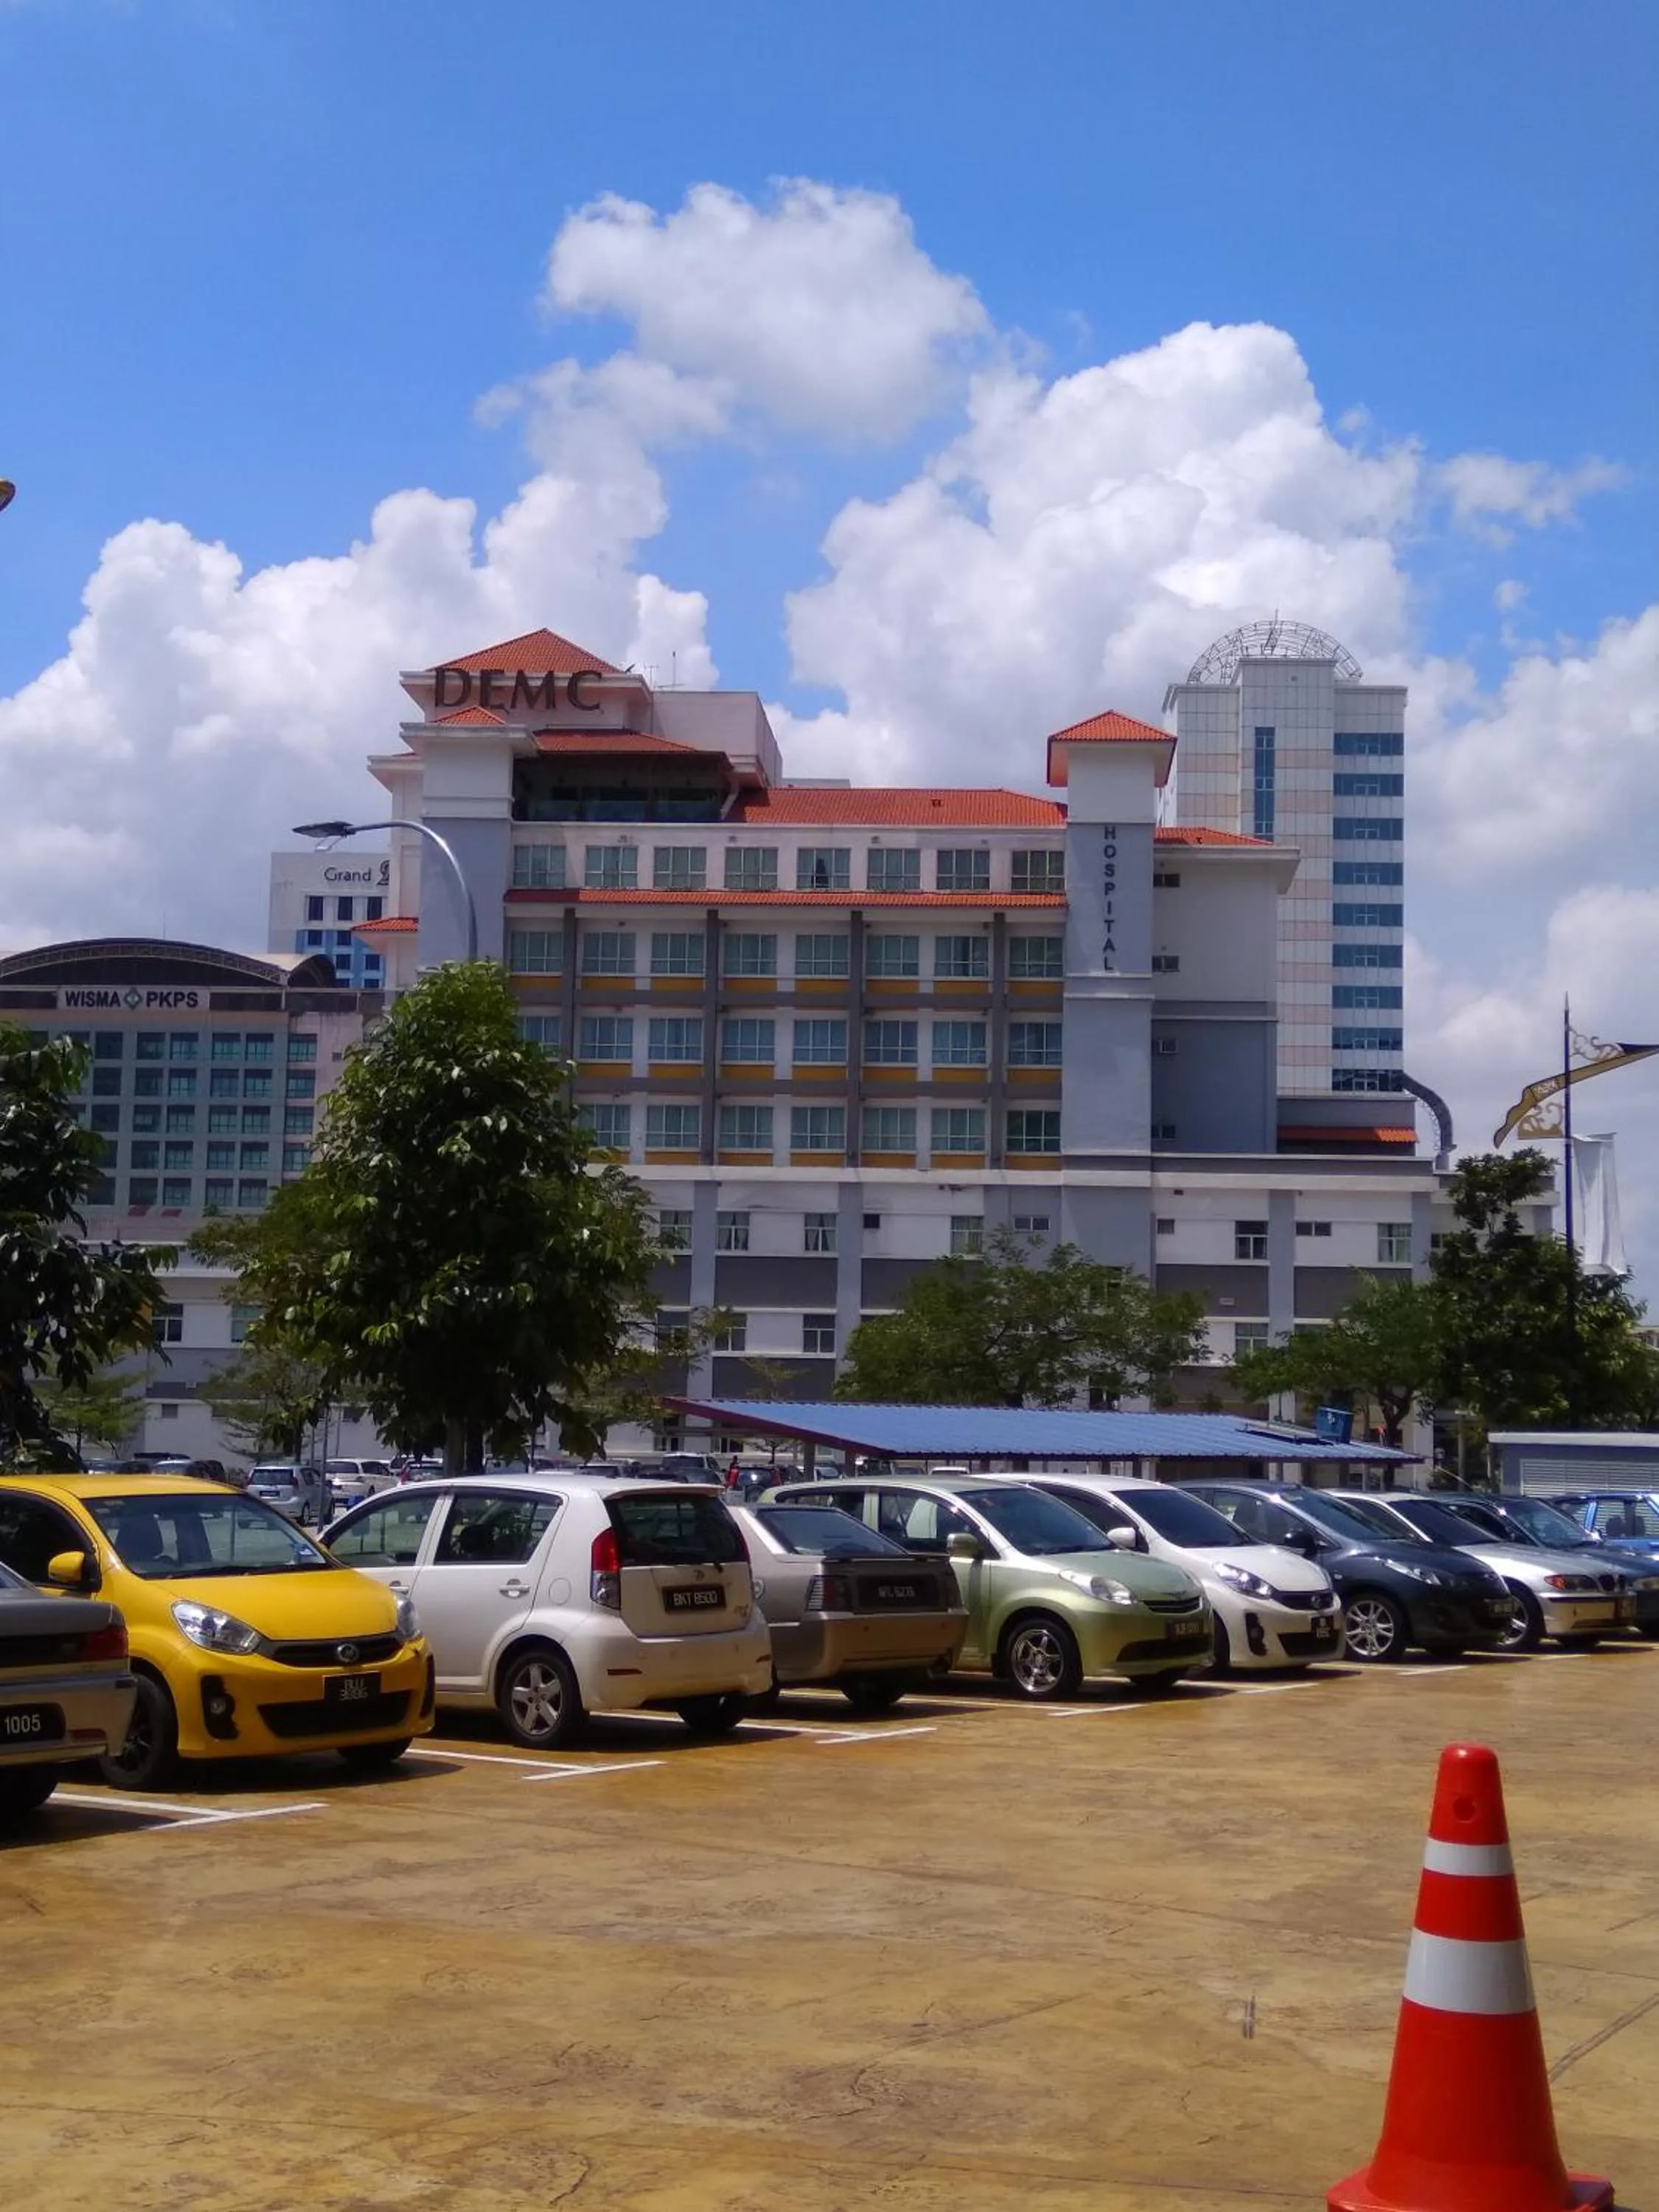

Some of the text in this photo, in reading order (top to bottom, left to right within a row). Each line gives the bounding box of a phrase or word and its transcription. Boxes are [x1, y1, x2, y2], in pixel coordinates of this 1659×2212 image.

[434, 667, 604, 714] DEMC
[324, 866, 372, 882] Grand
[1103, 825, 1117, 971] HOSPITAL
[65, 990, 199, 1009] WISMA PKPS
[4, 1714, 41, 1735] 1005
